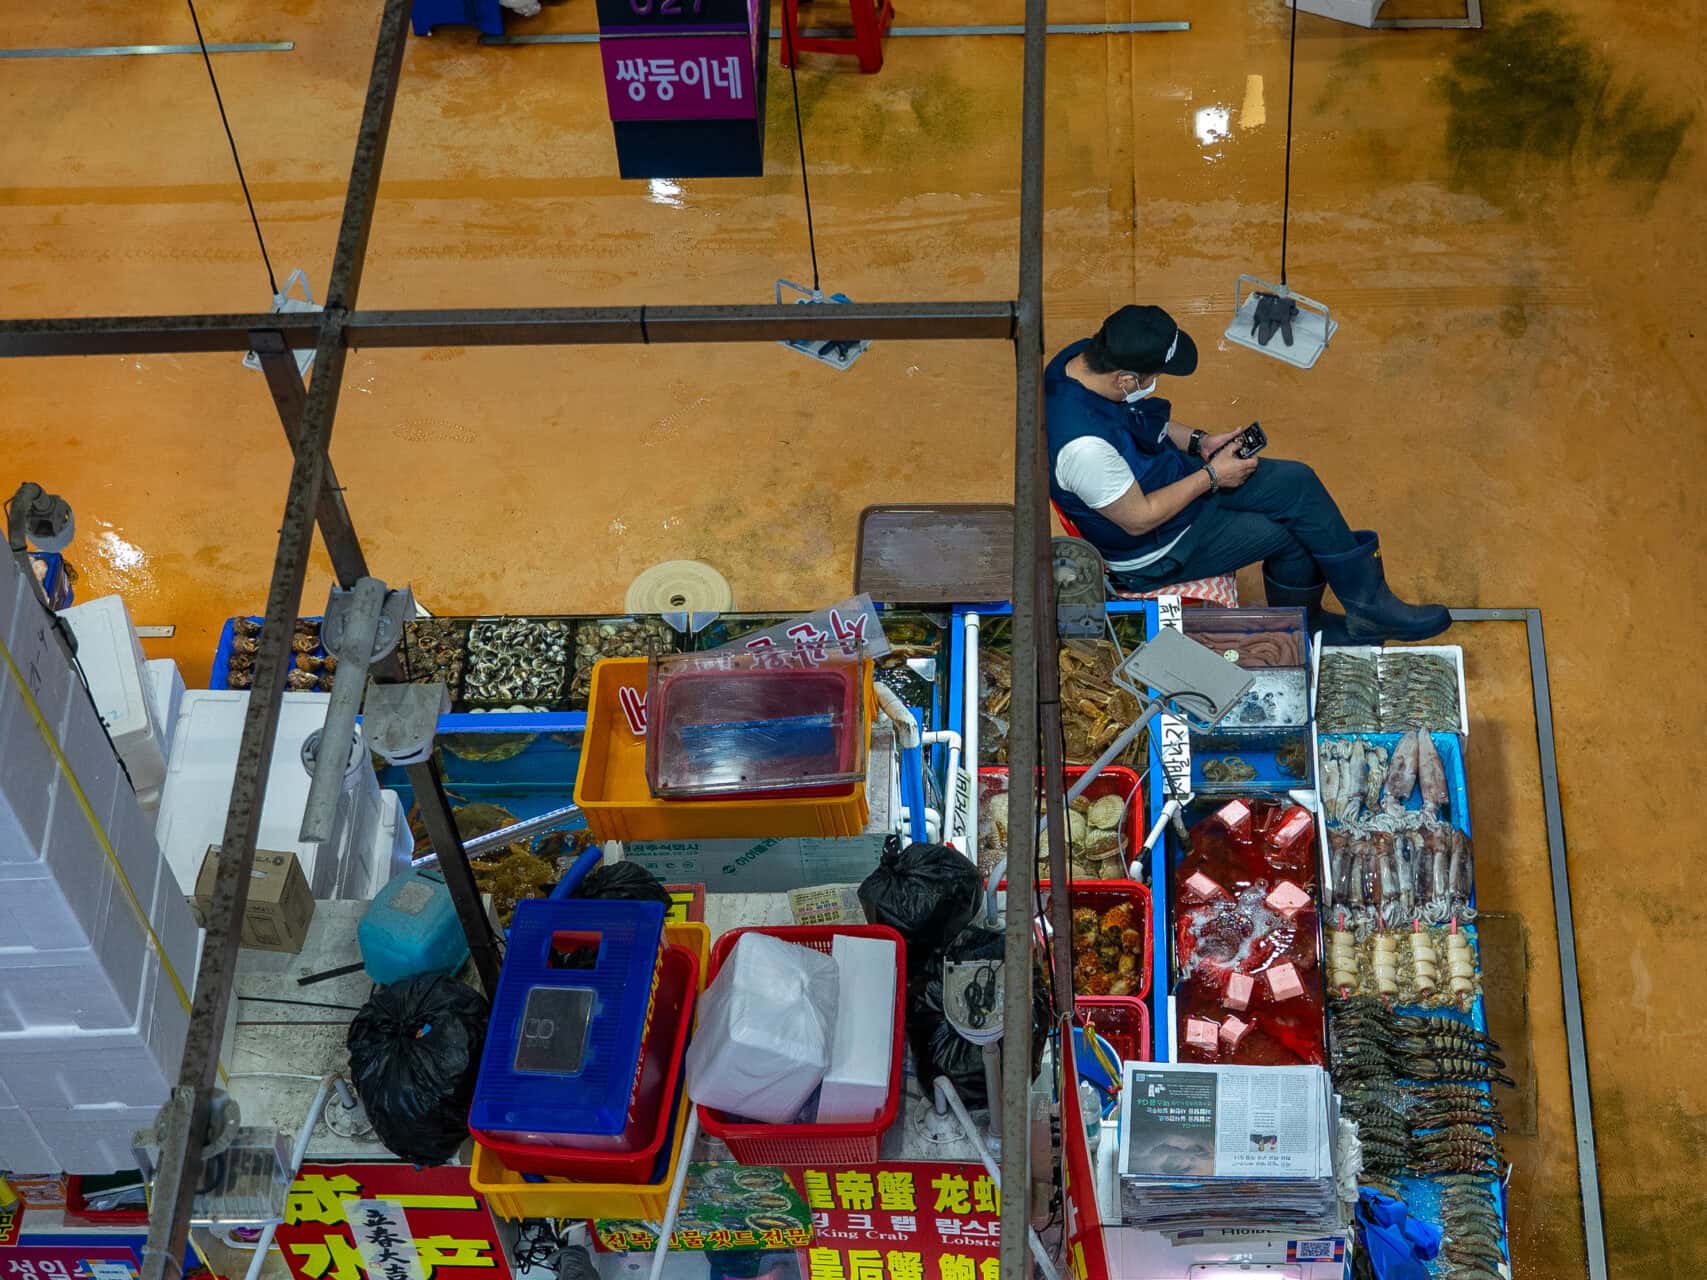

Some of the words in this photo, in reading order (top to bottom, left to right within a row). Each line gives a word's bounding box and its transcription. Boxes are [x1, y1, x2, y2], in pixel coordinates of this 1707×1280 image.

[615, 56, 743, 101] 쌍둥이네
[804, 1169, 918, 1212] 皇帝蟹
[816, 1227, 859, 1240] King
[865, 1230, 909, 1241] Crab
[942, 1235, 1001, 1247] Lobste
